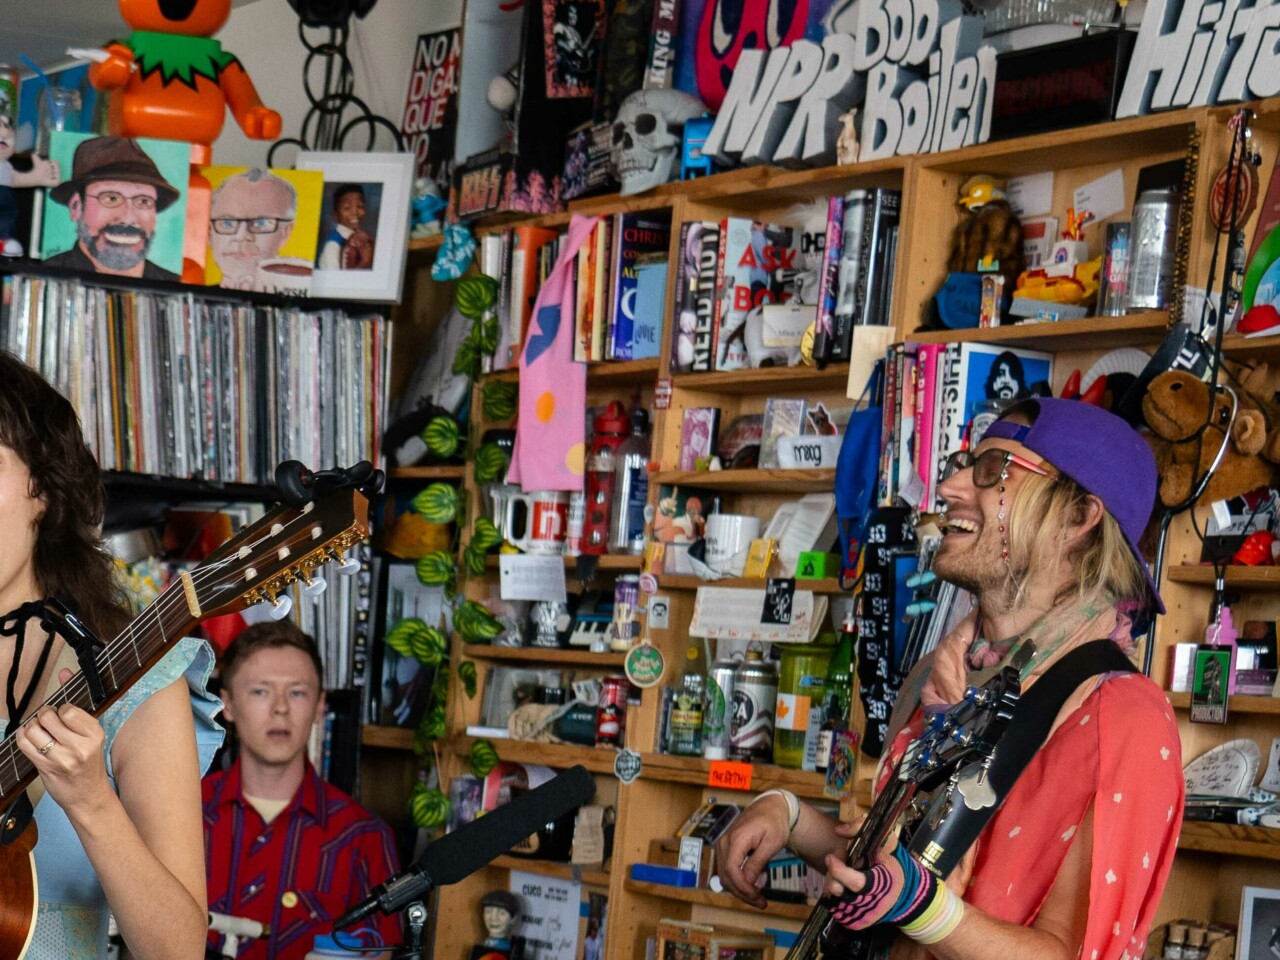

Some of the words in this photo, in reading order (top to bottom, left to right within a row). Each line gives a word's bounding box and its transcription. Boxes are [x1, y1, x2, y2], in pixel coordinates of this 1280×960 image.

[419, 35, 448, 70] NO
[410, 68, 458, 102] DIGA
[704, 34, 858, 162] NPR
[858, 16, 998, 163] Boilen
[403, 99, 446, 134] QUE
[738, 243, 797, 273] ASK
[792, 443, 822, 467] moog
[1191, 706, 1225, 722] PRODUCTION
